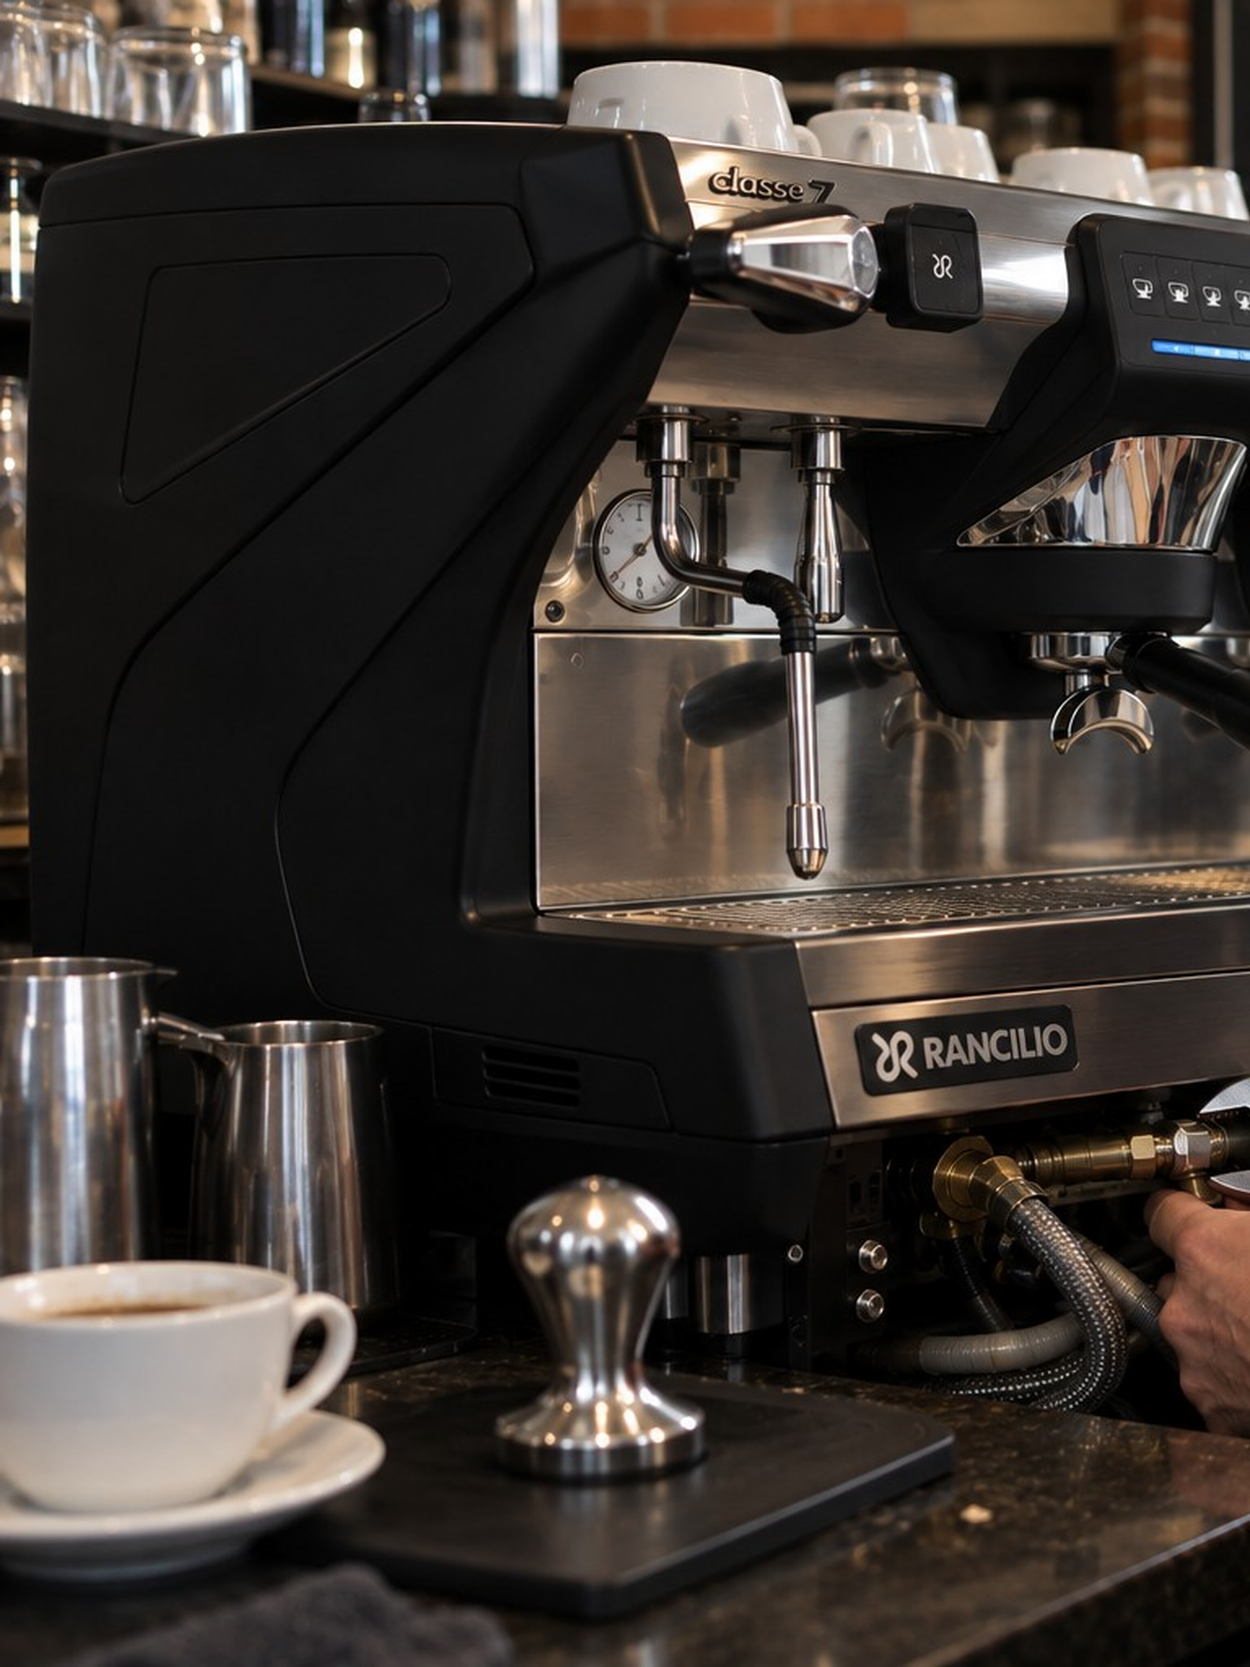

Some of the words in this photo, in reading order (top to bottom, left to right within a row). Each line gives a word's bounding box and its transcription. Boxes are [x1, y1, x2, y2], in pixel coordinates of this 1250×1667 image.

[708, 166, 804, 202] classe
[808, 179, 837, 203] 7
[922, 1023, 1068, 1069] RANCILIO
